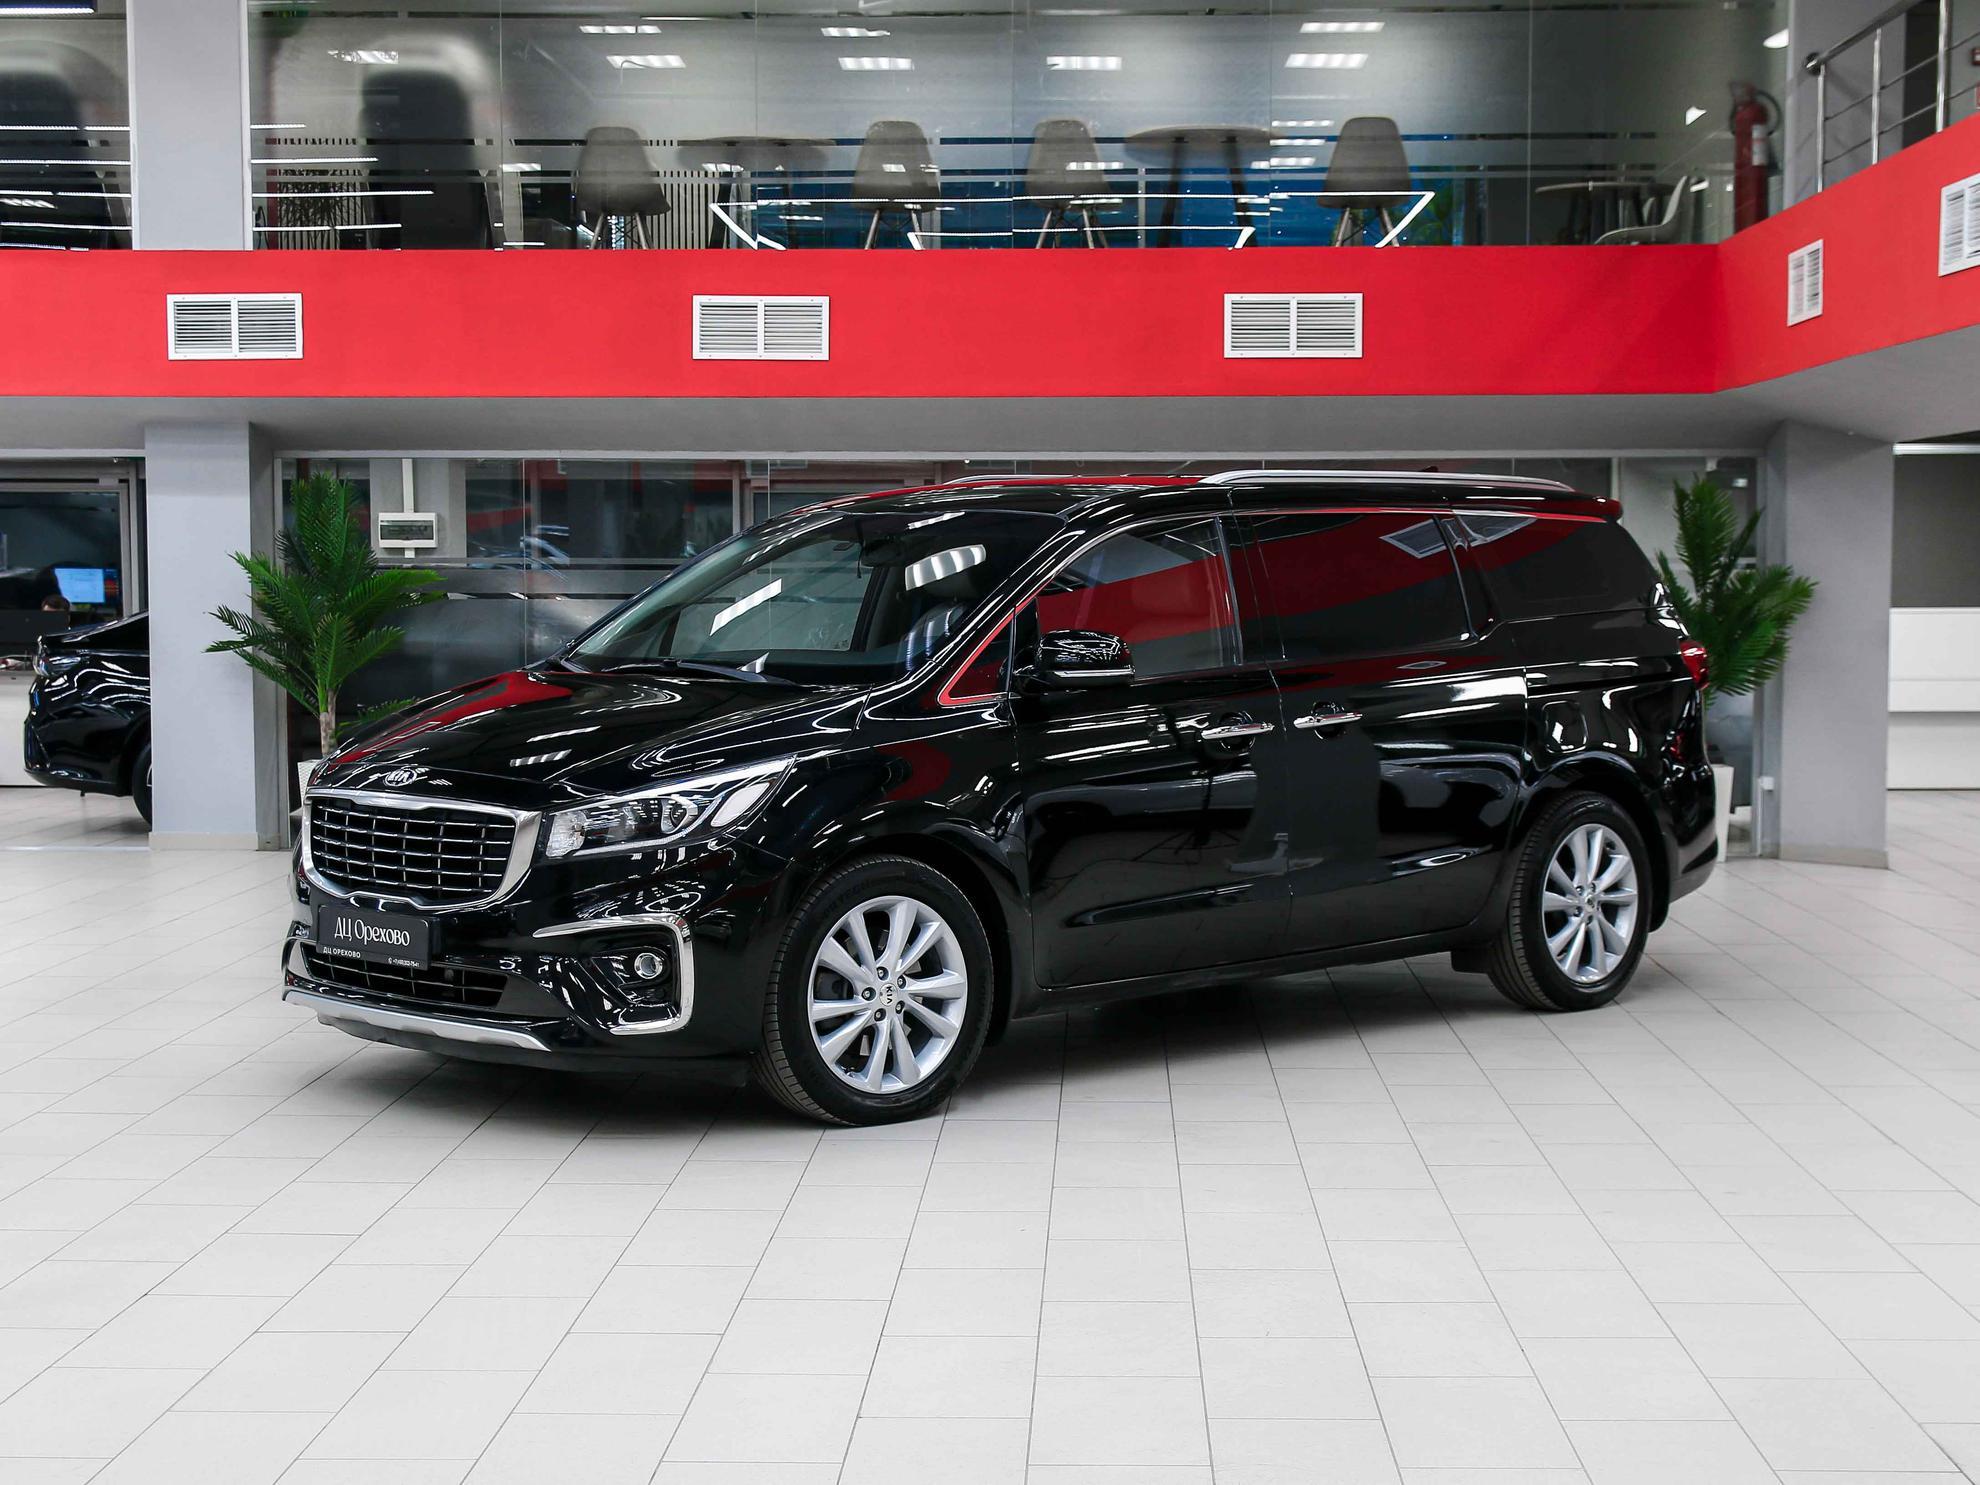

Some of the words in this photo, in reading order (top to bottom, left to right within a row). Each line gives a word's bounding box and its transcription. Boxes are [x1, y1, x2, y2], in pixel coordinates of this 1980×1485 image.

[335, 917, 352, 942] ДЦ
[354, 919, 411, 946] Орехово
[333, 948, 361, 959] ОРЕХОВО
